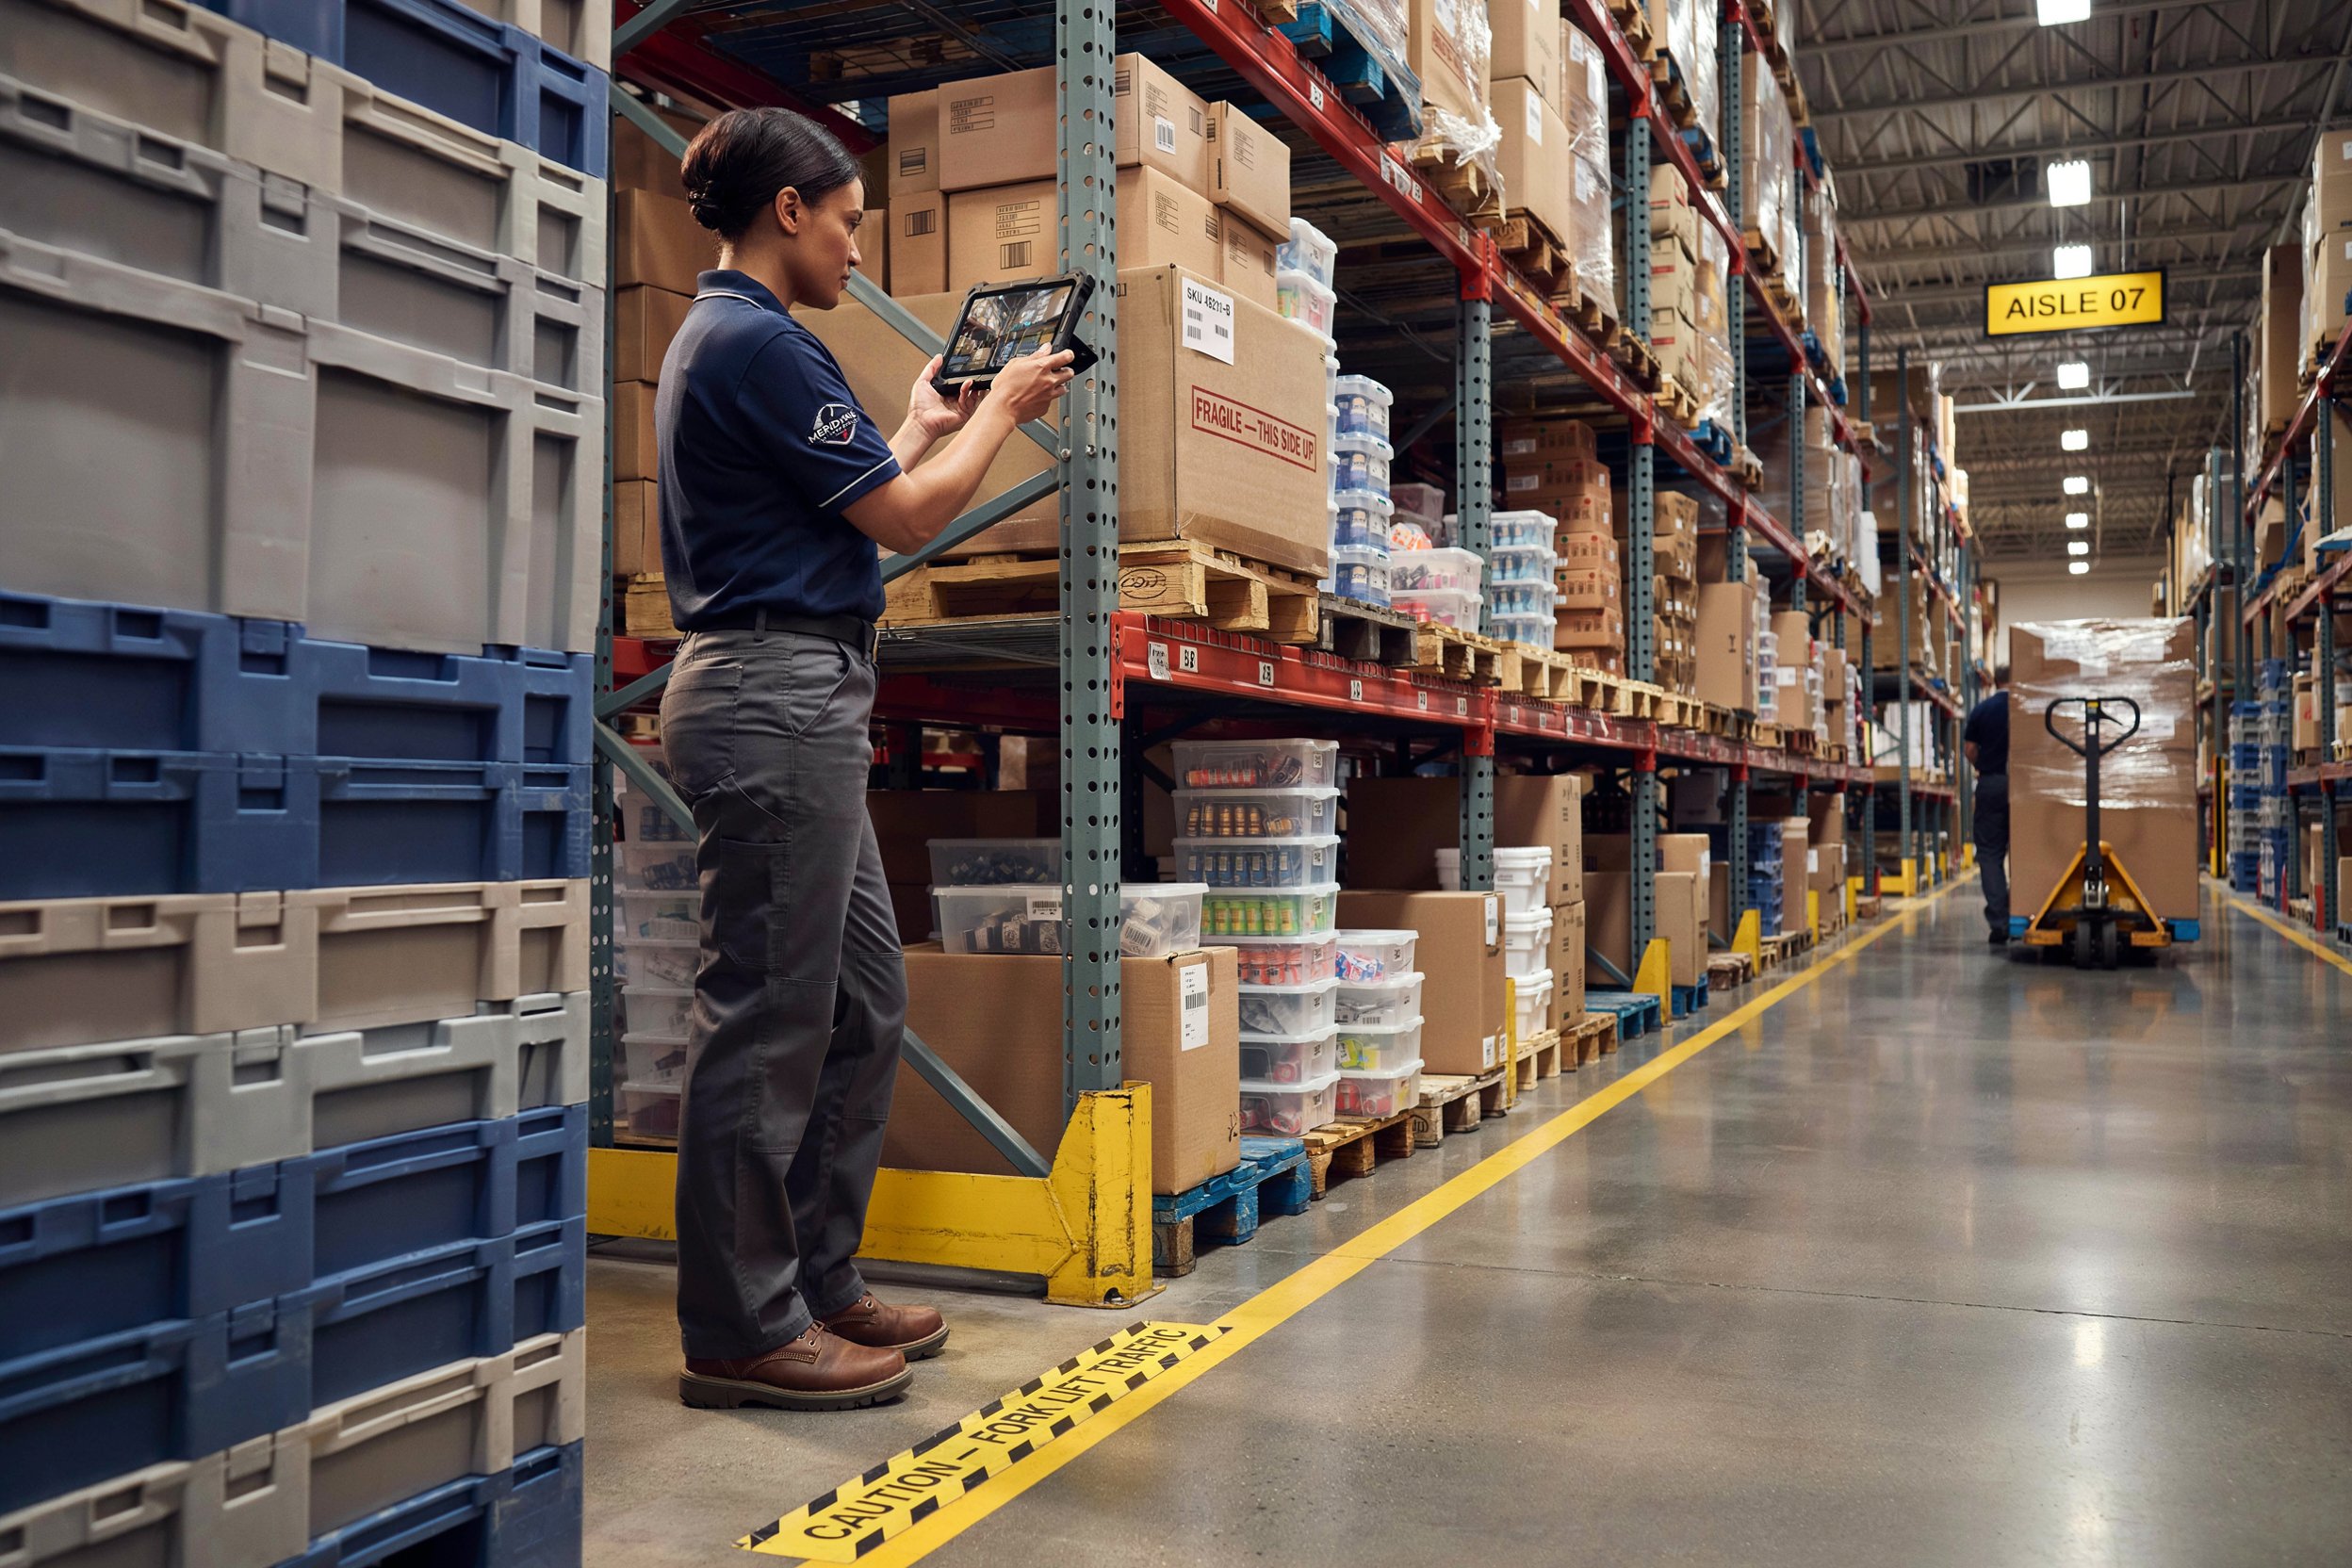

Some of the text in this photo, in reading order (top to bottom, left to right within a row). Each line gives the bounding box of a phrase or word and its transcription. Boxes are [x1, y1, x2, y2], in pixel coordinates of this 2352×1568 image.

[1186, 286, 1202, 304] SKU
[2006, 288, 2146, 319] AISLE 07
[1196, 397, 1242, 433] FRAGILE
[1257, 419, 1279, 448] THIS
[1281, 429, 1301, 456] SIDE
[1302, 438, 1314, 461] UP
[804, 1461, 963, 1540] CAUTION
[969, 1402, 1065, 1445] FORK
[1038, 1375, 1106, 1404] LIFT
[1086, 1329, 1187, 1375] TRAFFIC
